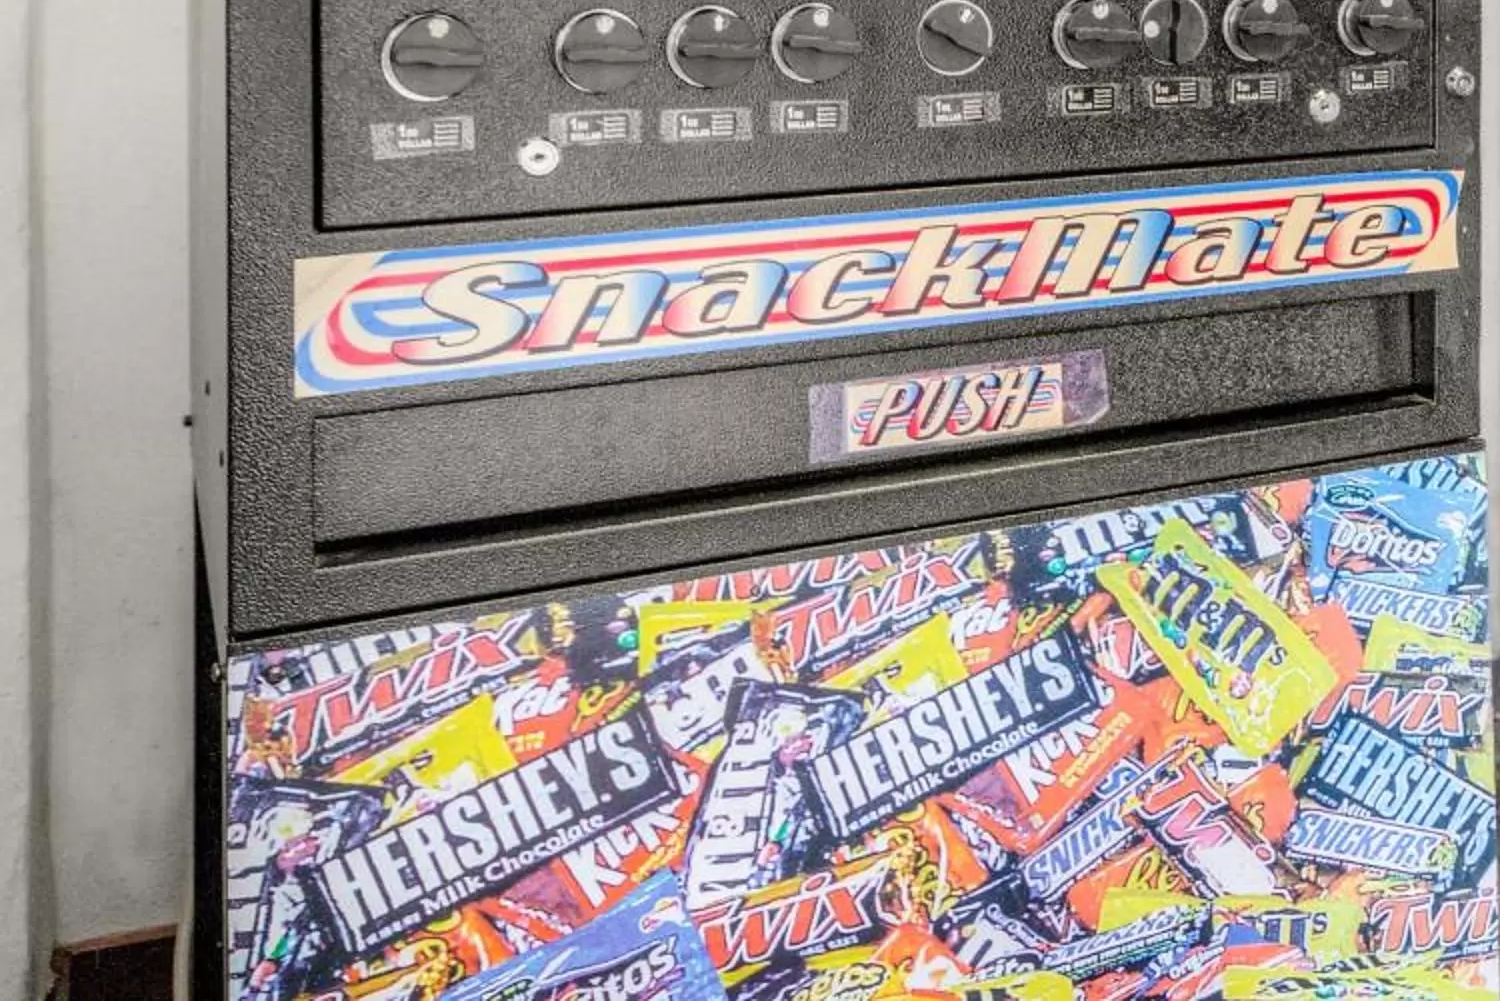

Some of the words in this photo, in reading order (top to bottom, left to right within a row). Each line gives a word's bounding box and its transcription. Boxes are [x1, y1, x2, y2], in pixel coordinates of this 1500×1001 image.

[860, 366, 1042, 446] PUSH
[1330, 519, 1443, 567] Doritos
[1337, 581, 1462, 634] SNICKERS
[815, 639, 1076, 836] HERSHEY'S
[893, 771, 945, 808] Milk
[942, 720, 1040, 779] Chocolate
[322, 720, 650, 930] HERSHEY'S
[1320, 718, 1496, 865] HERSHEY'S
[421, 872, 488, 917] Milk
[484, 815, 606, 883] Chocolate
[1298, 813, 1436, 868] SNICKERS
